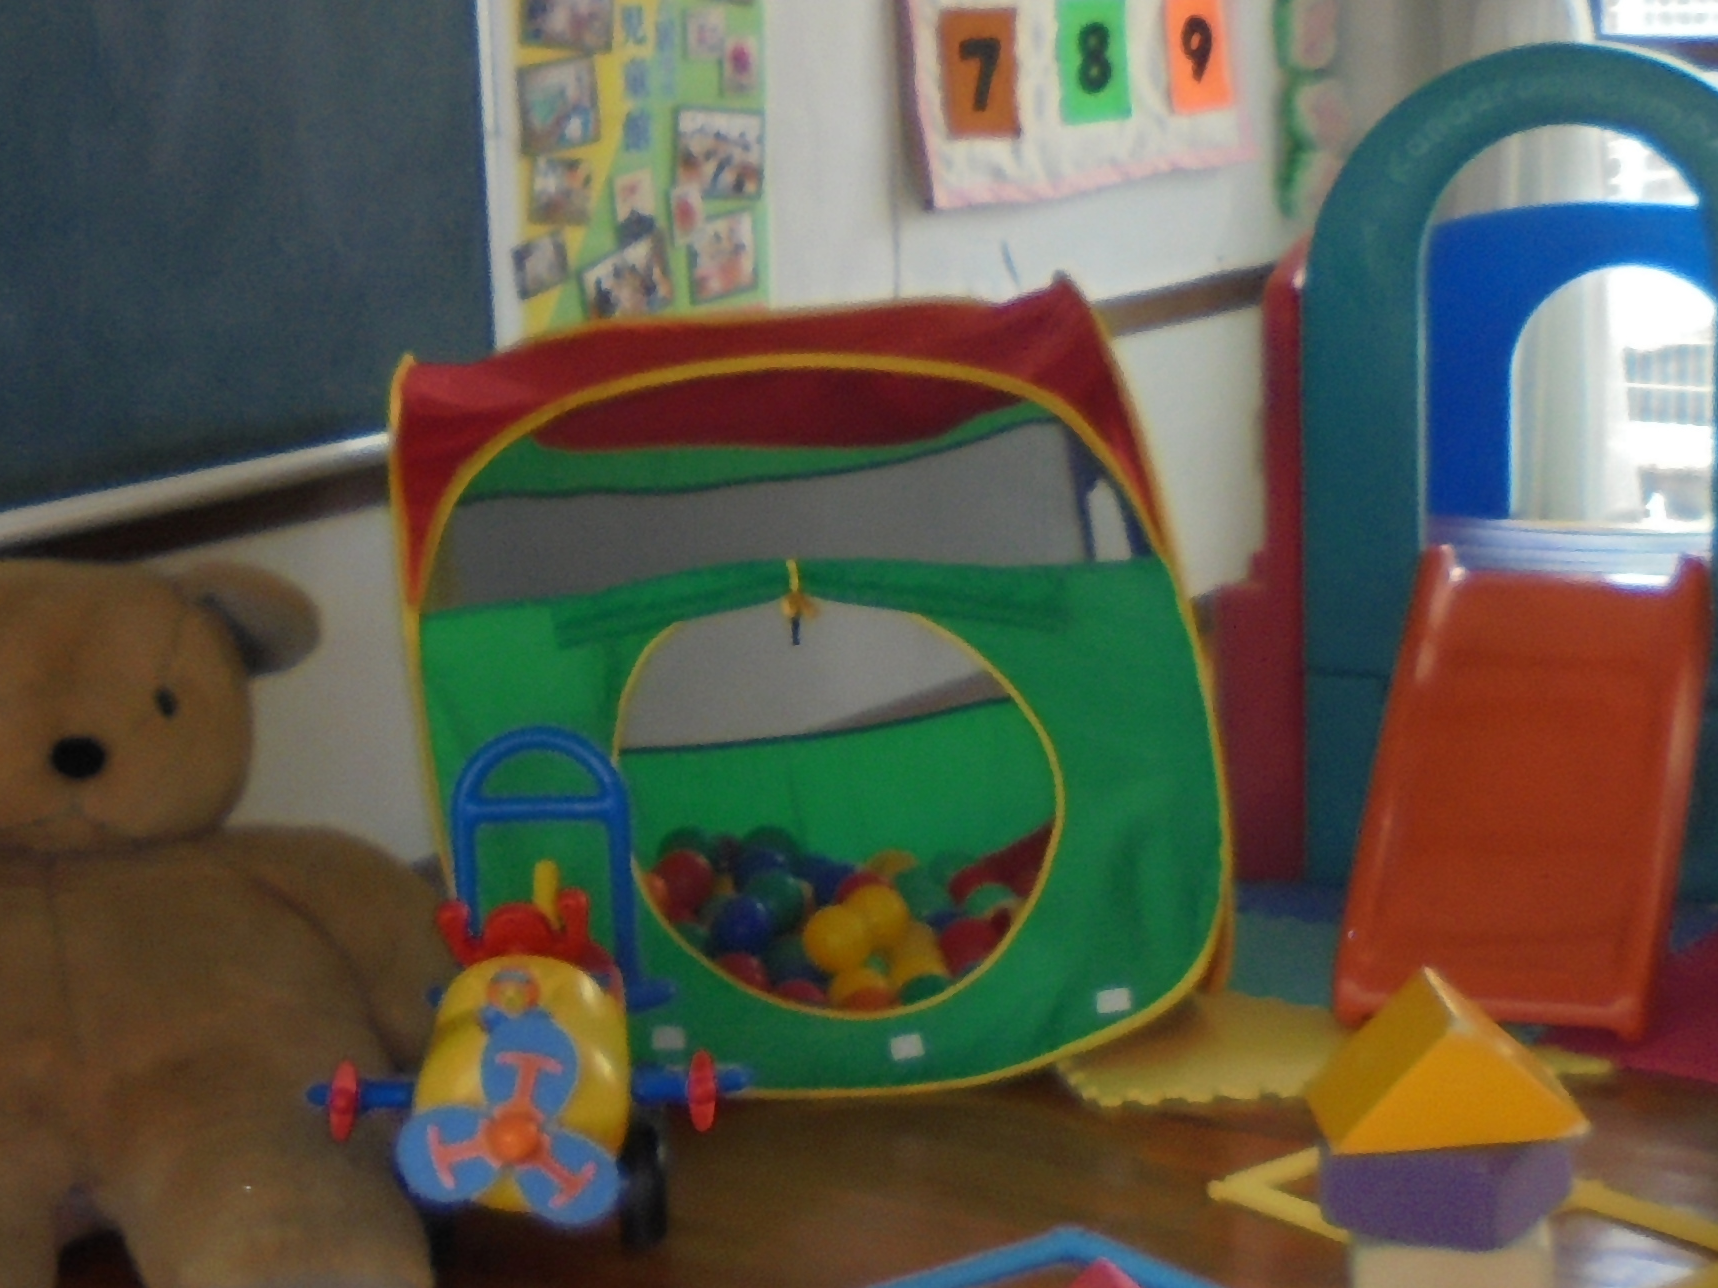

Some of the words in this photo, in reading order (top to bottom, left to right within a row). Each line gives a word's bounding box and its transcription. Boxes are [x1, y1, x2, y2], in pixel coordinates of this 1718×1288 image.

[958, 36, 1001, 112] 7
[1076, 21, 1112, 95] 8
[1180, 15, 1213, 85] 9
